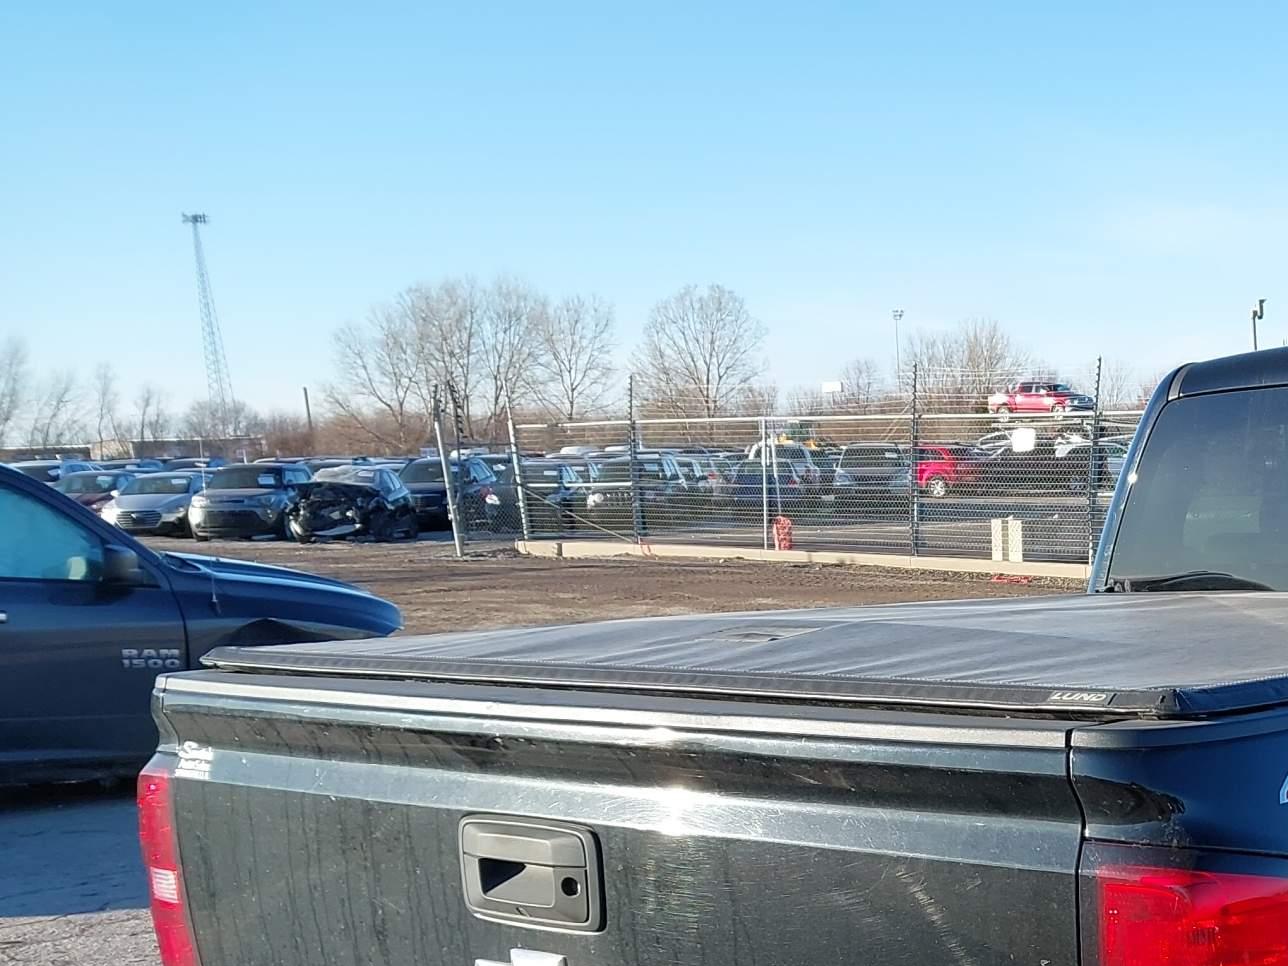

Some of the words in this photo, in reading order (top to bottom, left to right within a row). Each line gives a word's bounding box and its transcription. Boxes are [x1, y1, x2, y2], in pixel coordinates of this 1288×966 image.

[121, 648, 180, 658] RAM
[121, 658, 181, 669] 1500
[1050, 692, 1107, 702] LUND
